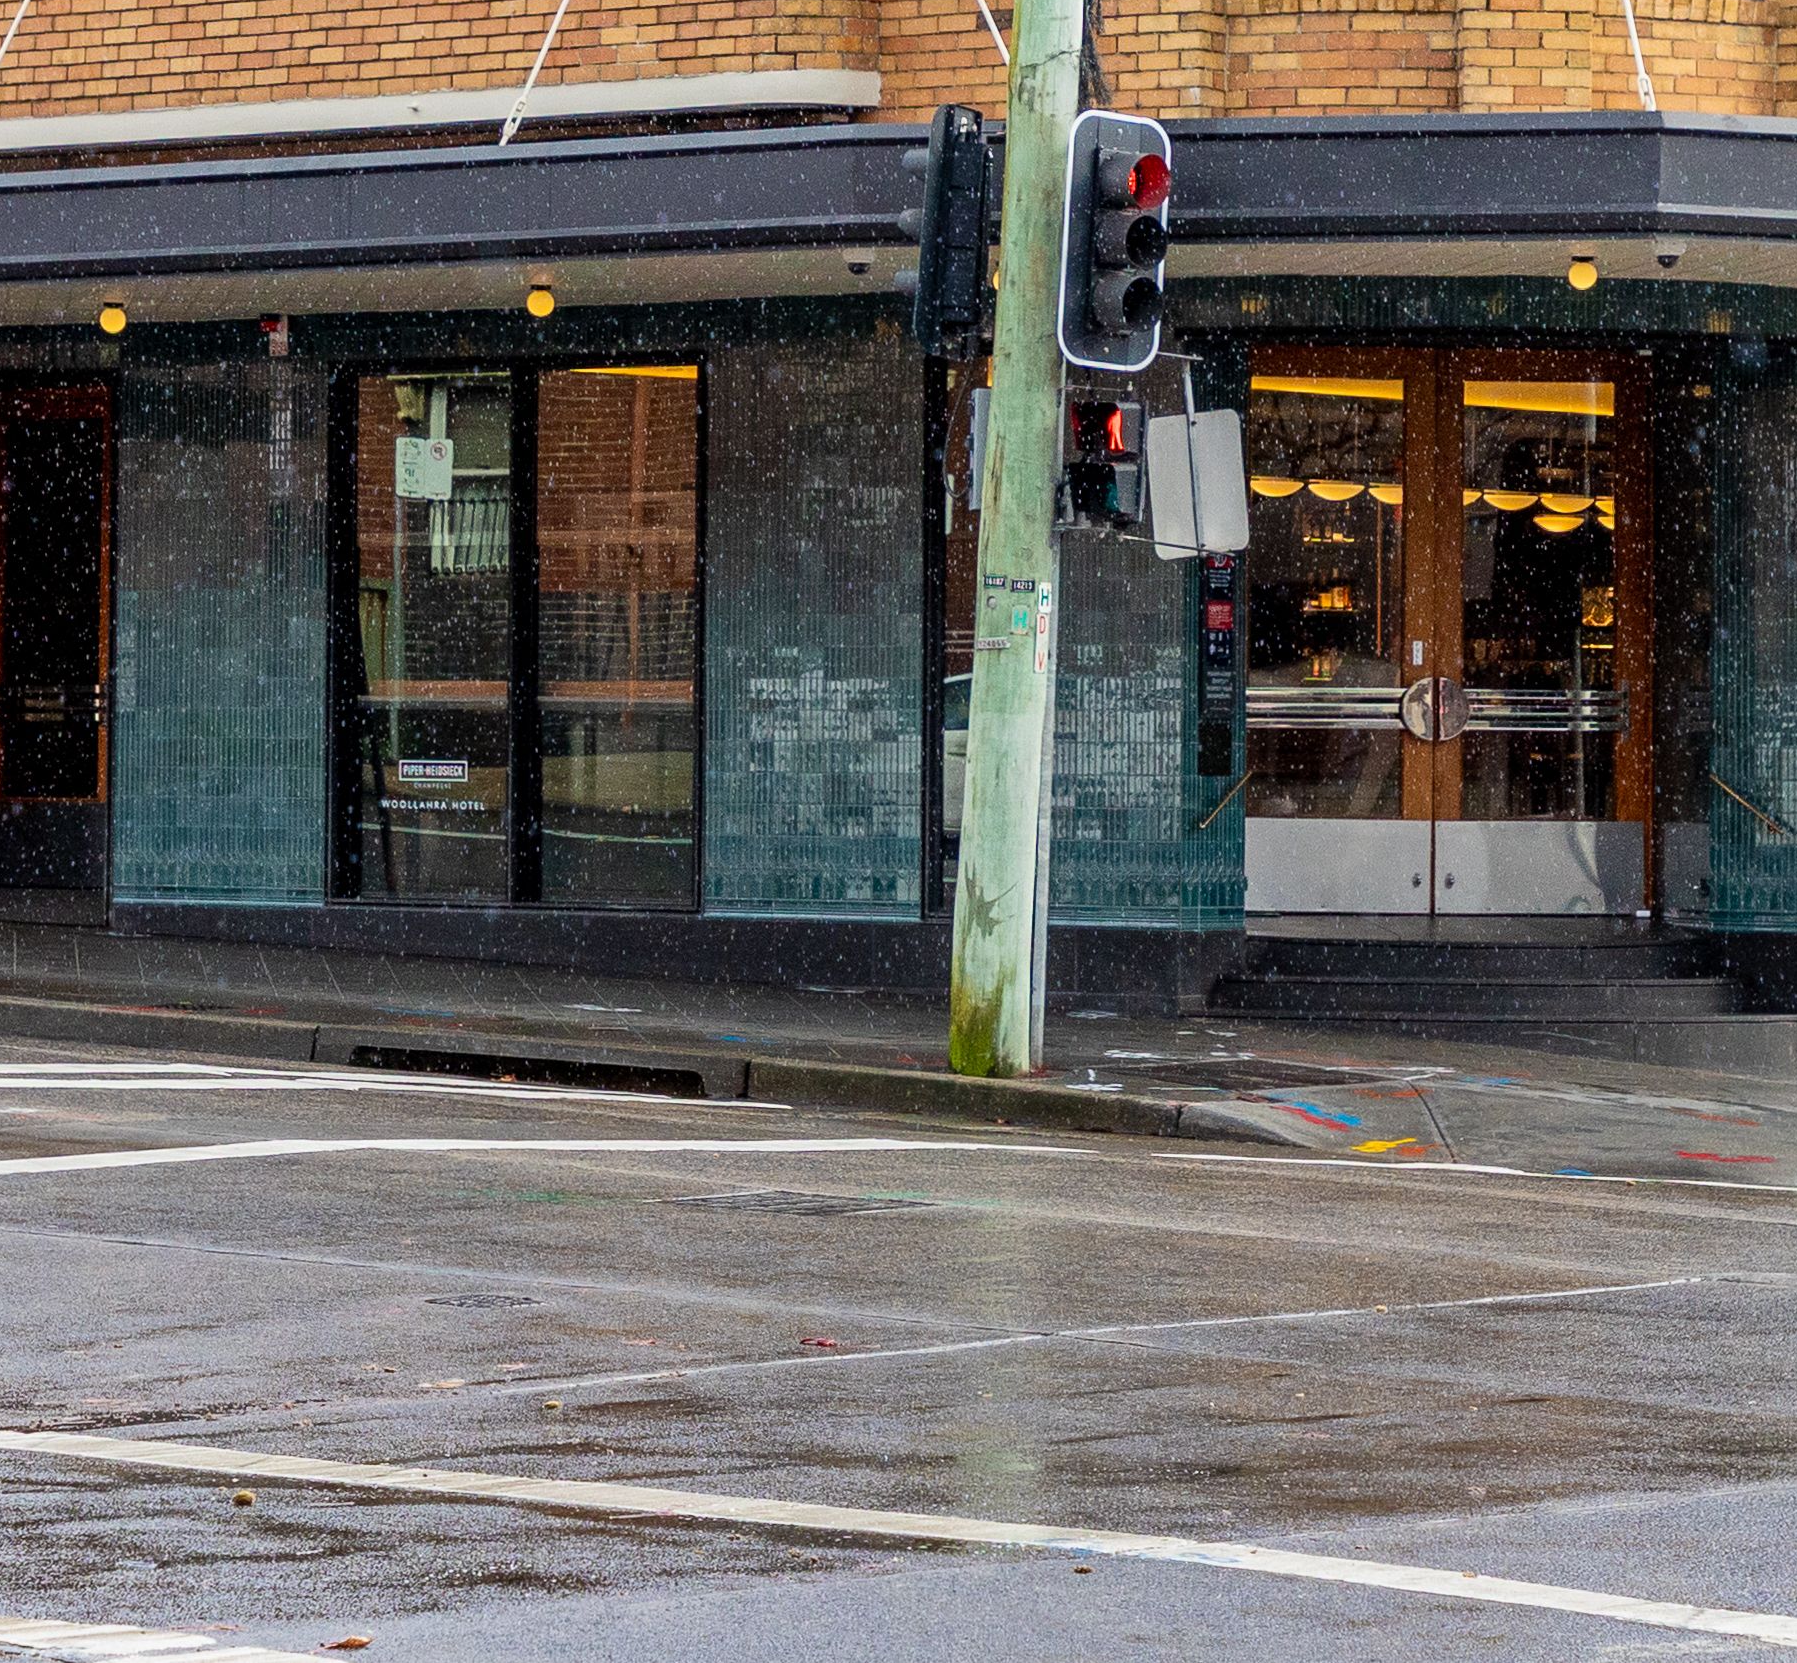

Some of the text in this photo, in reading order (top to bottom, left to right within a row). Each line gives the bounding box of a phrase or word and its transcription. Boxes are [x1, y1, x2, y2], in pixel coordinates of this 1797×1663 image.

[1041, 587, 1049, 607] H
[1013, 609, 1028, 629] H
[1039, 615, 1046, 634] D
[402, 764, 463, 777] PIPER-HEIDSIECK
[381, 799, 485, 811] WOOLLAHRA HOTEL
